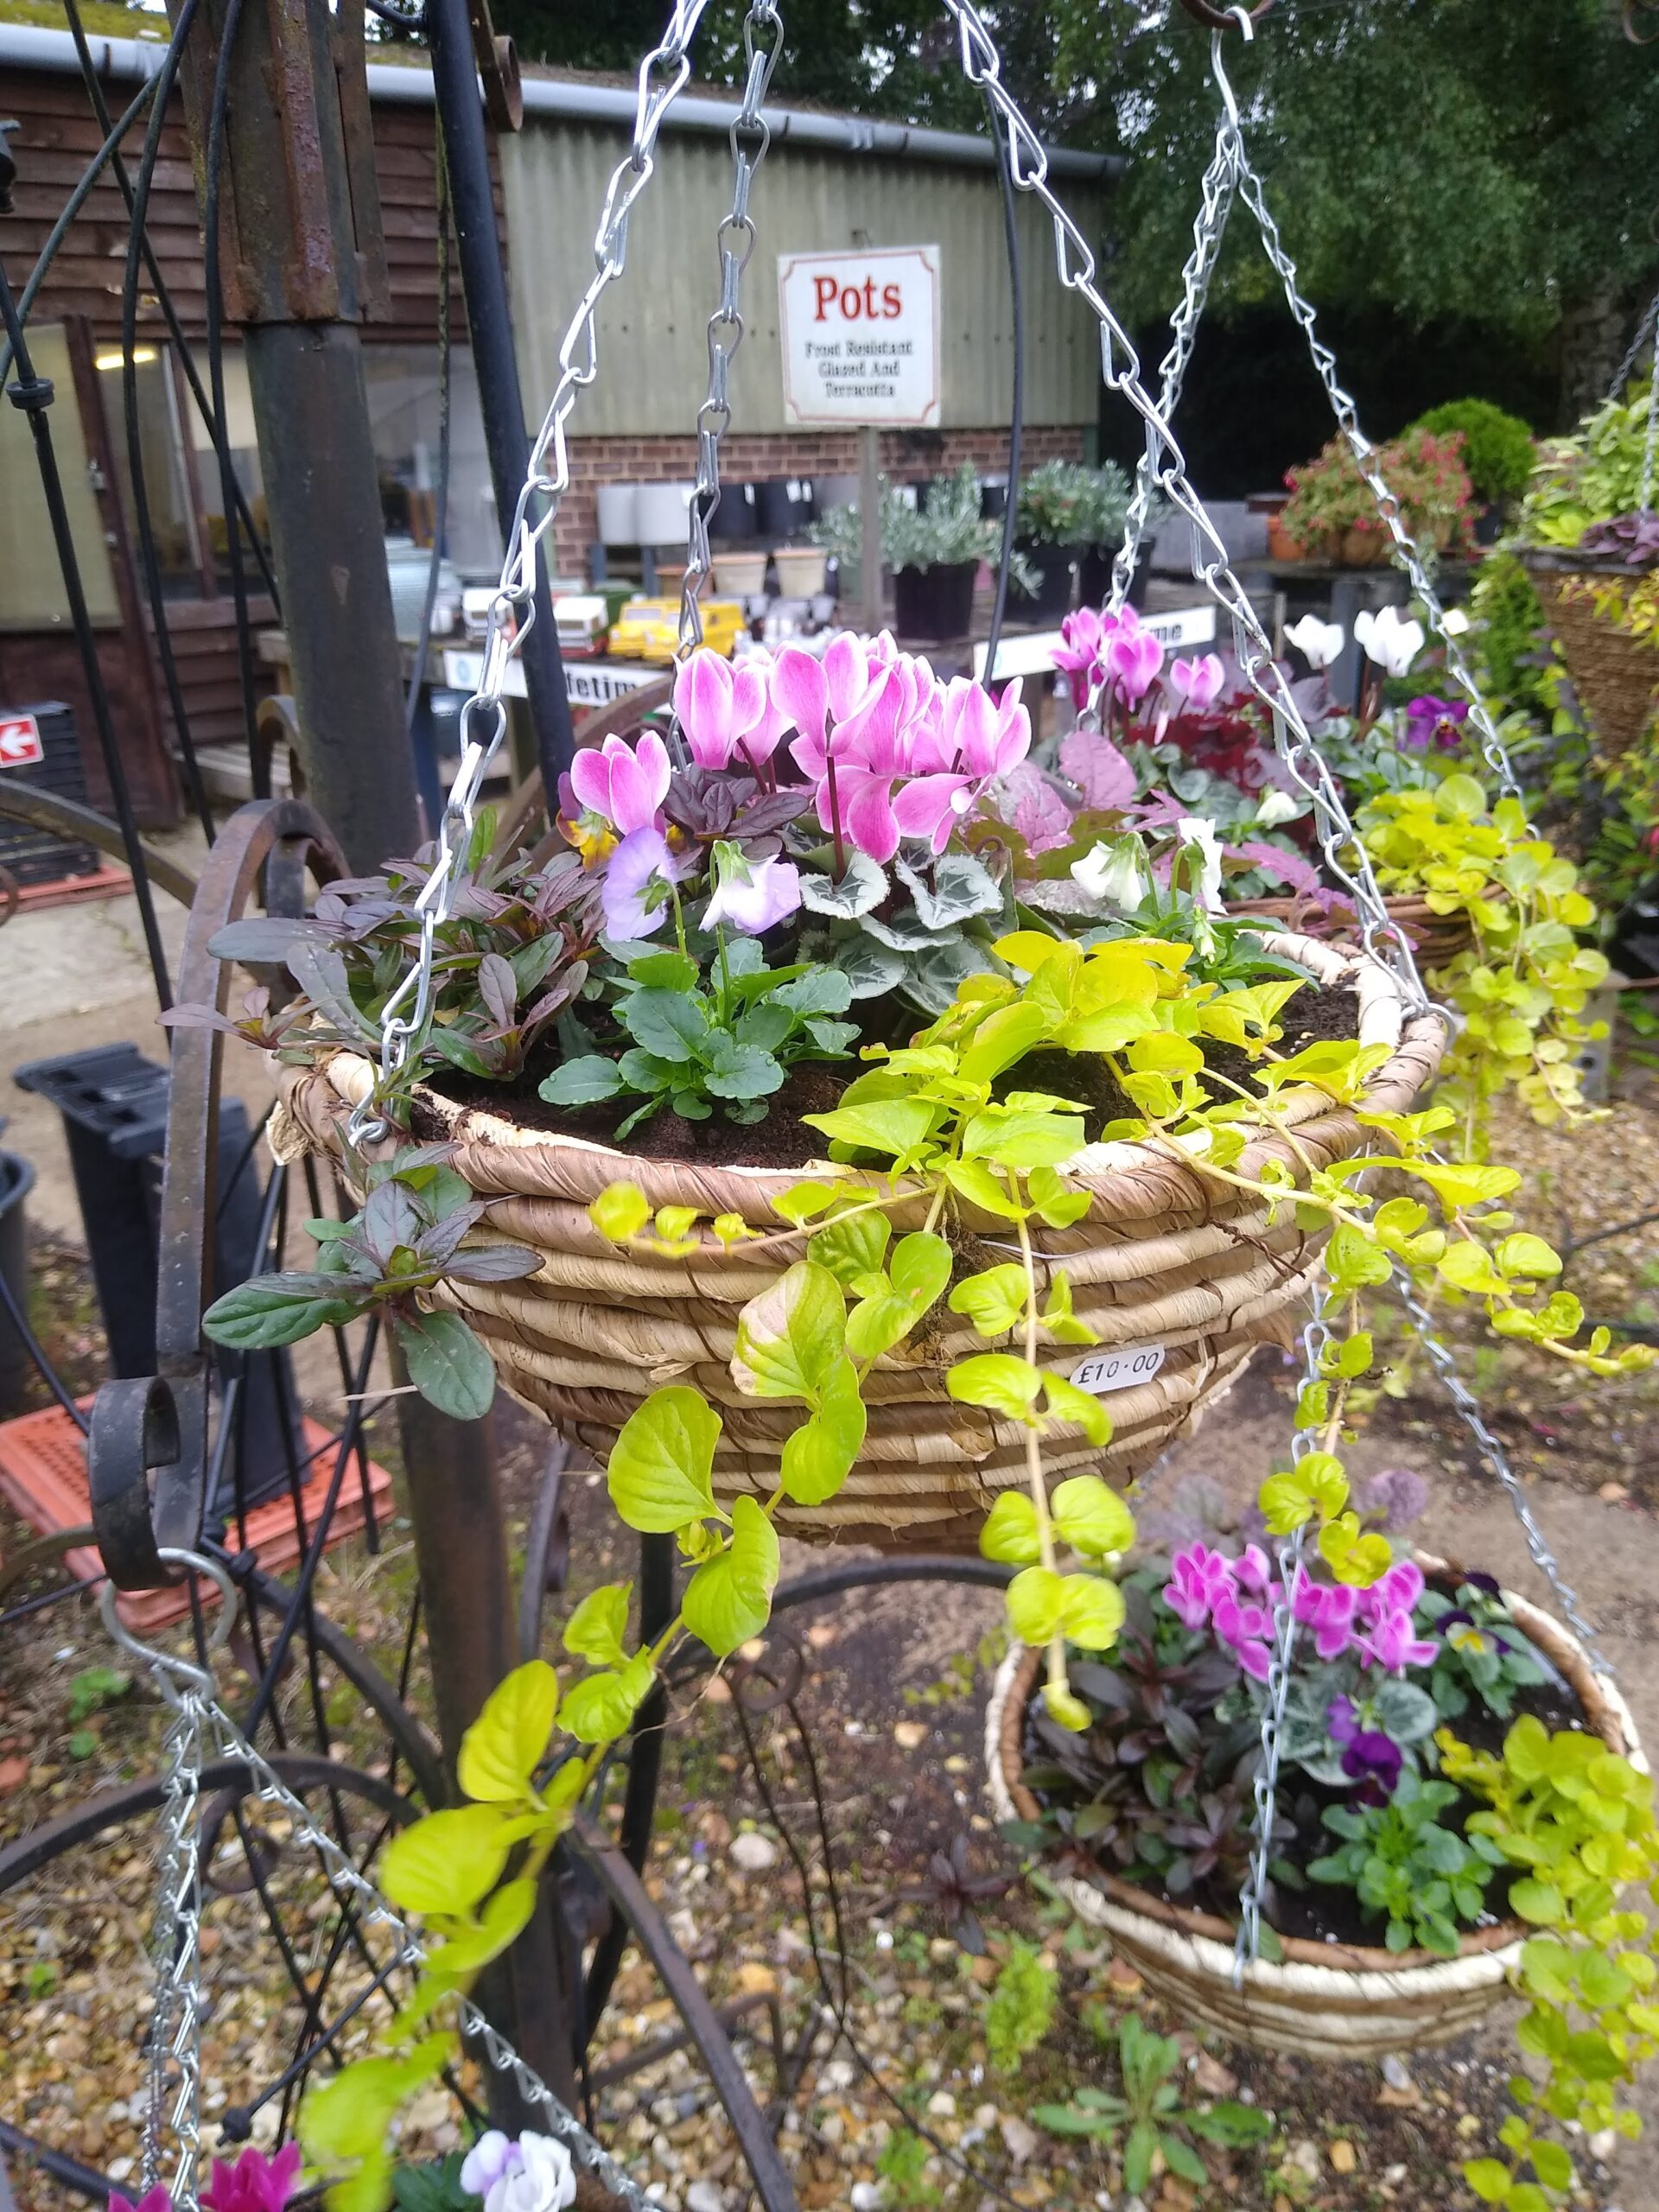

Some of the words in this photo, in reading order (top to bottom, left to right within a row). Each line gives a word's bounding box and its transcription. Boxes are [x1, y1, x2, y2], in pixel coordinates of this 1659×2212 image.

[812, 276, 901, 321] Pots
[805, 341, 841, 358] Frost
[846, 340, 912, 356] Resistant
[818, 361, 864, 377] Glazed
[872, 361, 899, 377] And
[565, 671, 637, 699] fetim
